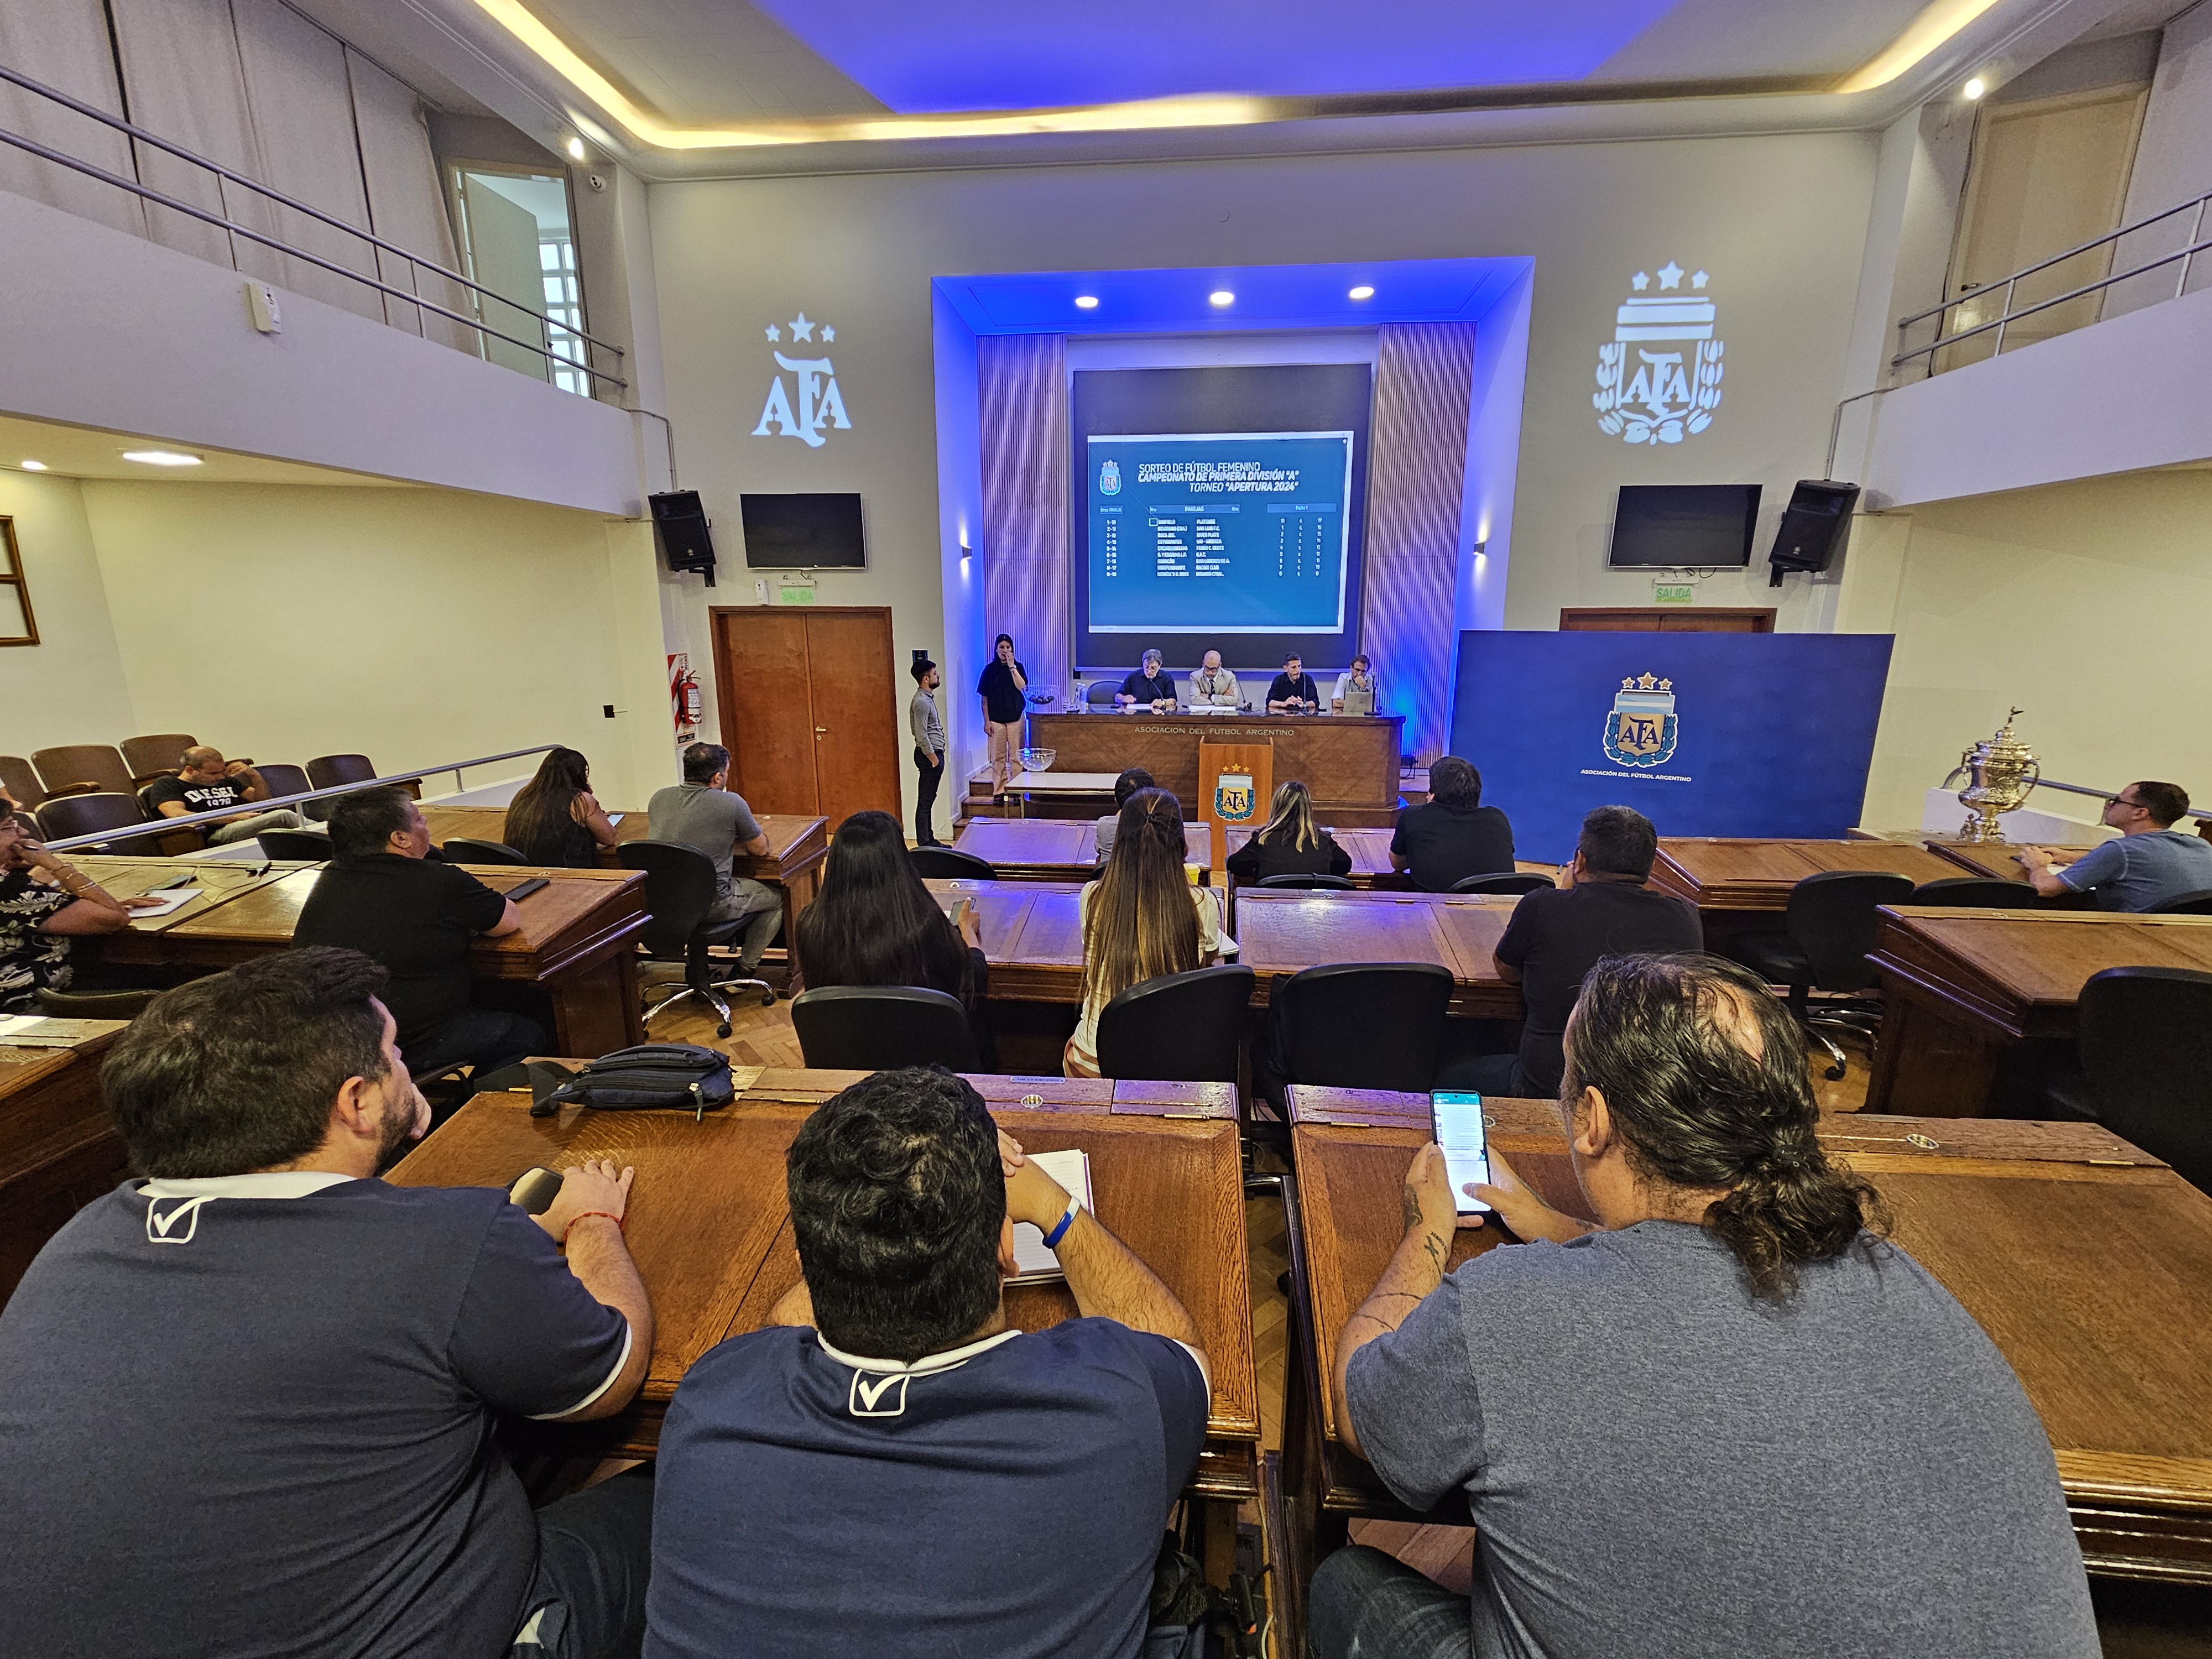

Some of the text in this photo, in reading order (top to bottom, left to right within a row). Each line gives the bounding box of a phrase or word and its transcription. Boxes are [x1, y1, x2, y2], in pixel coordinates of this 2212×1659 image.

[1621, 348, 1691, 416] AFA
[751, 351, 852, 447] AFA
[1139, 461, 1260, 473] SORTEO DE FÚTBOL FEMENINO
[1138, 468, 1299, 482] CAMPEONATO DE PRIMERA DIVISIÓN "A"
[1190, 481, 1299, 492] TORNEO "APERTURA 2024"
[781, 589, 813, 602] SALIDA
[1657, 588, 1692, 598] SALIDA
[1618, 716, 1660, 750] AFA
[184, 786, 238, 803] DIESEL
[1223, 790, 1246, 811] AFA
